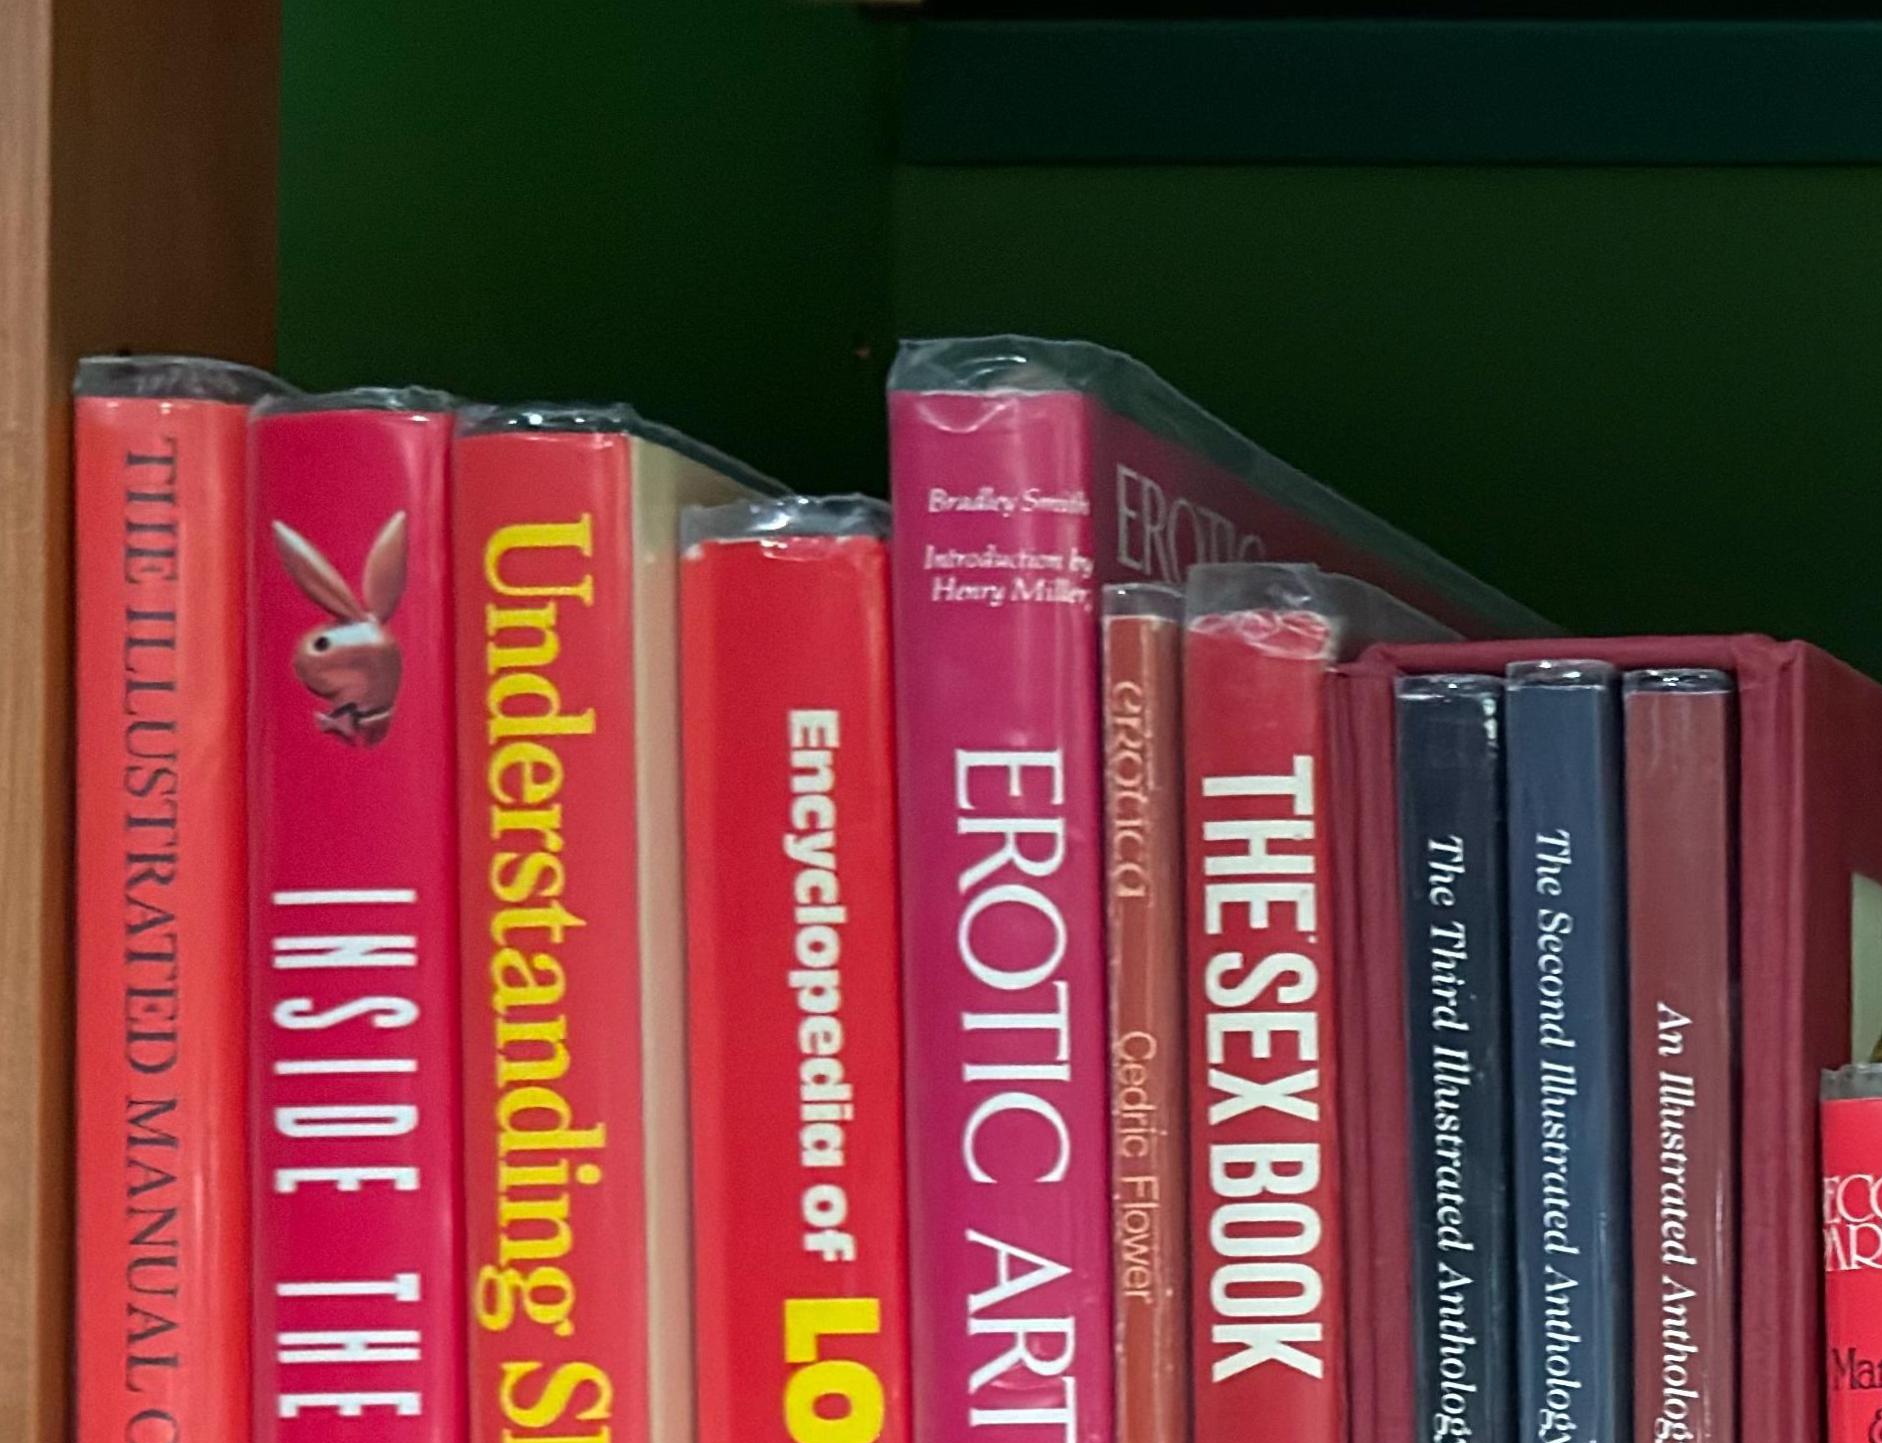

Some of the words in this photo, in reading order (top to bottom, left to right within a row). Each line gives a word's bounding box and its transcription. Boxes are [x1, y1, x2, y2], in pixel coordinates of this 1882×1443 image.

[125, 439, 177, 585] THE
[125, 609, 179, 1075] ILLUSTRATED
[476, 513, 606, 1336] Understanding
[1202, 756, 1317, 936] THE
[1427, 836, 1464, 907] The
[784, 709, 854, 1167] Encyclopedia
[955, 748, 1072, 1184] EROTIC
[1429, 919, 1472, 1030] Third
[273, 891, 419, 1192] INSIDE
[1117, 1030, 1166, 1160] Cedric
[1205, 953, 1320, 1125] SEX
[803, 1185, 855, 1262] of
[1433, 1046, 1474, 1251] Illustrated
[127, 1098, 179, 1392] MANUAL
[1121, 1177, 1160, 1304] Flower
[1208, 1143, 1323, 1381] BOOK
[276, 1274, 421, 1416] THE
